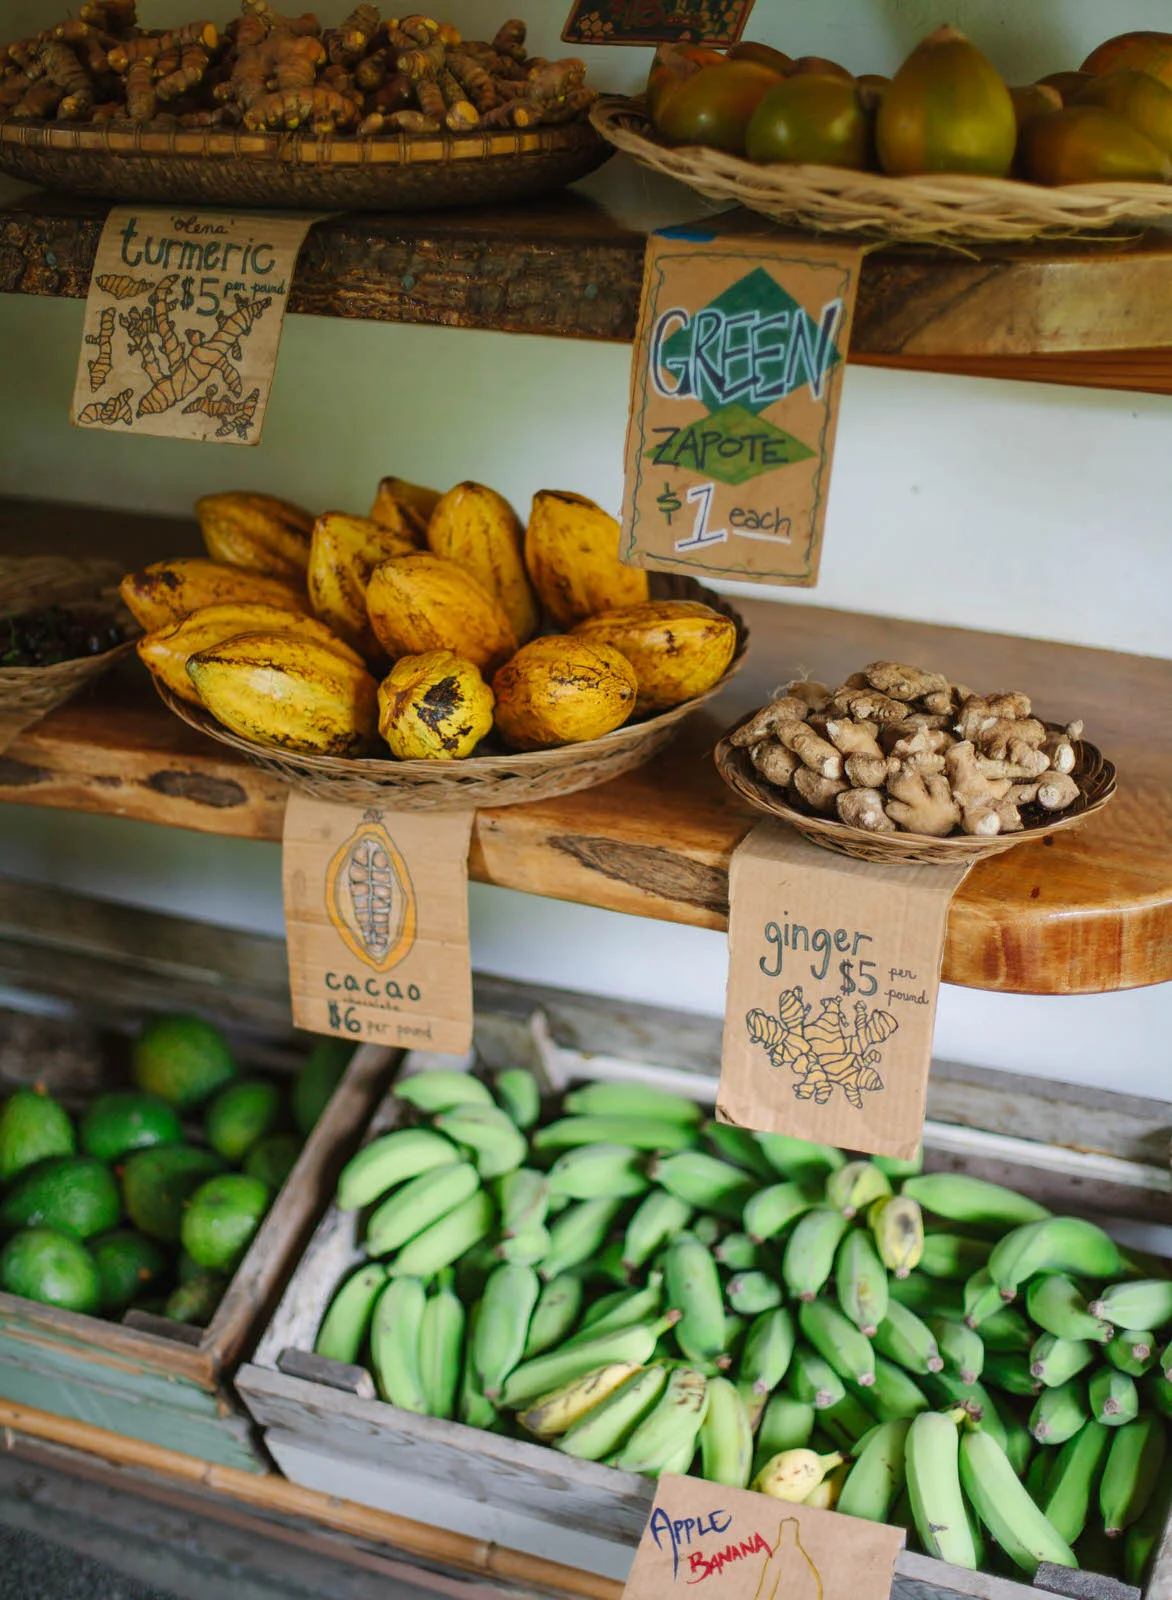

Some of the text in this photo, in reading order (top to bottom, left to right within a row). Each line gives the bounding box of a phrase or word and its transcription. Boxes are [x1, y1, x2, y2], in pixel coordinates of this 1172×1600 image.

[120, 217, 276, 275] turmeric
[179, 276, 286, 316] $5 per pound
[651, 297, 842, 403] GREEN
[651, 427, 789, 469] ZAPOTE
[728, 507, 791, 536] each
[759, 911, 873, 980] ginger
[325, 972, 421, 1001] cacao
[839, 959, 917, 996] $5 per
[884, 988, 929, 1006] pound
[328, 1000, 433, 1041] $6 per pound
[650, 1507, 732, 1581] APPLE
[686, 1532, 773, 1585] BANANA
